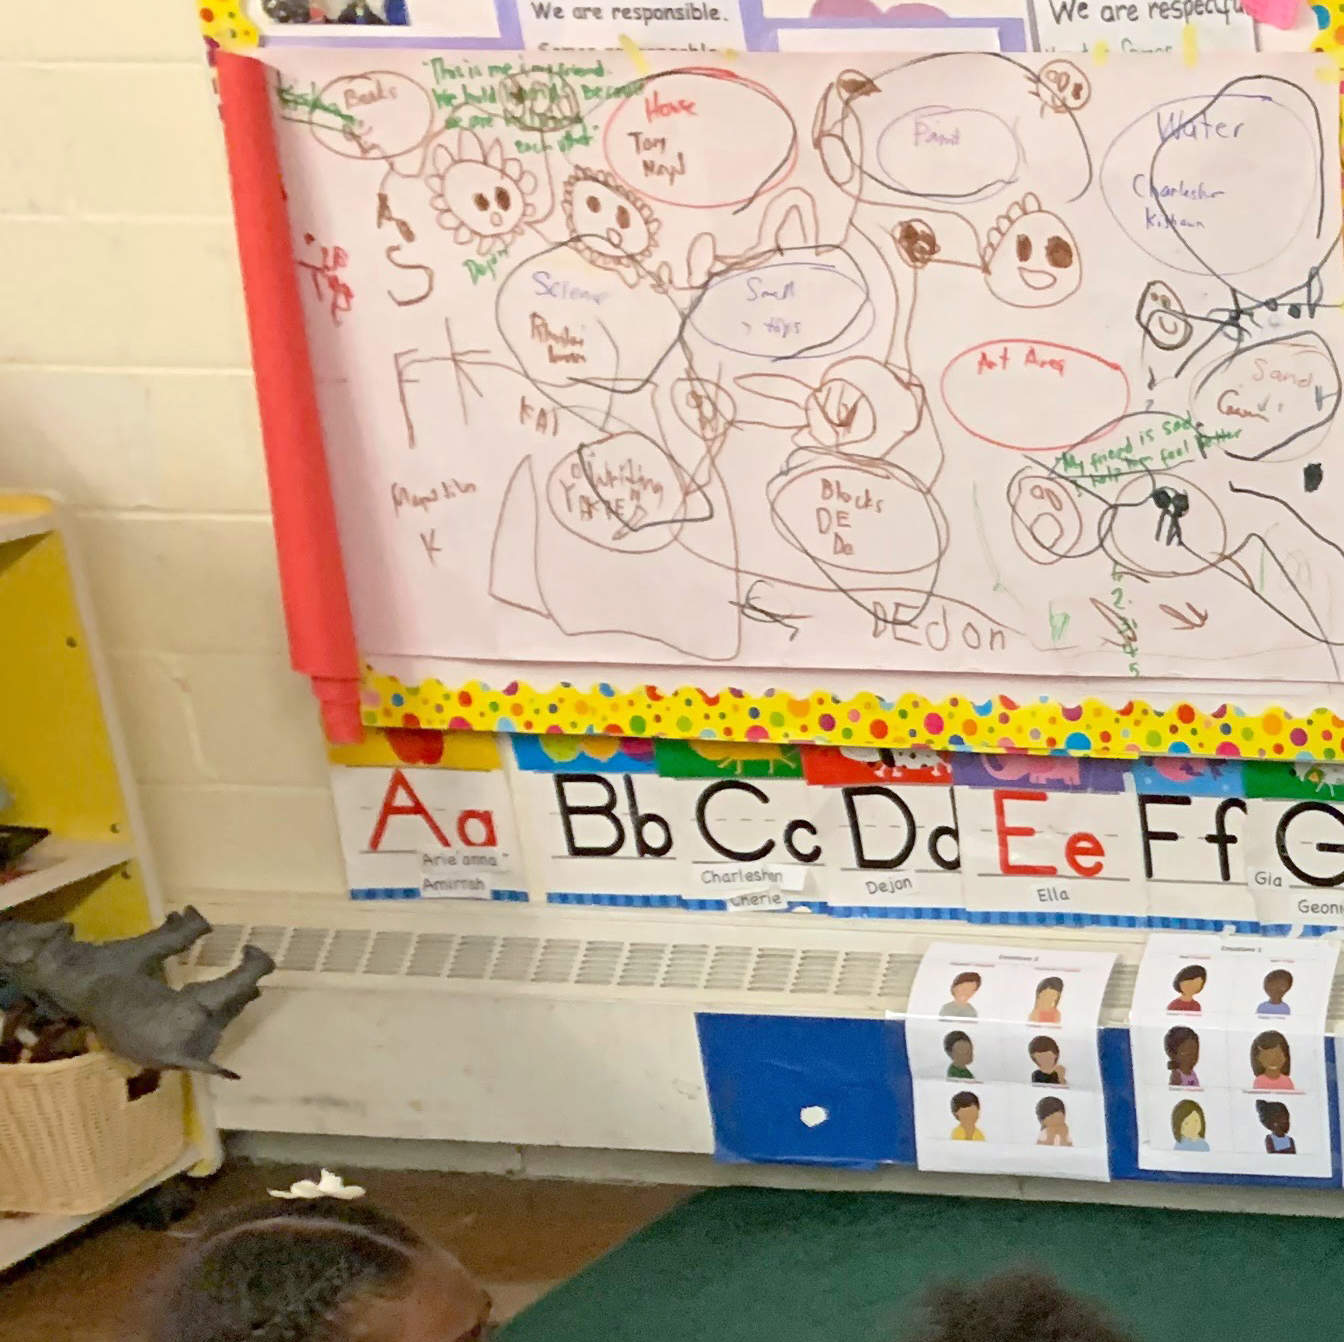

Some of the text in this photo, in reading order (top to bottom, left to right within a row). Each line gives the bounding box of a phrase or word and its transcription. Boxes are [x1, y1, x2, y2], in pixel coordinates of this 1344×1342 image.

[531, 1, 729, 26] We are responsible.
[1050, 0, 1139, 25] We are
[1157, 110, 1245, 142] Water
[371, 768, 497, 850] Aa
[555, 772, 673, 859] Bb
[696, 779, 822, 864] Cc
[842, 784, 961, 870] Dd
[994, 789, 1105, 877] Ee
[1138, 794, 1246, 883] Ff
[1038, 886, 1070, 903] Ella
[1255, 872, 1282, 888] Gia
